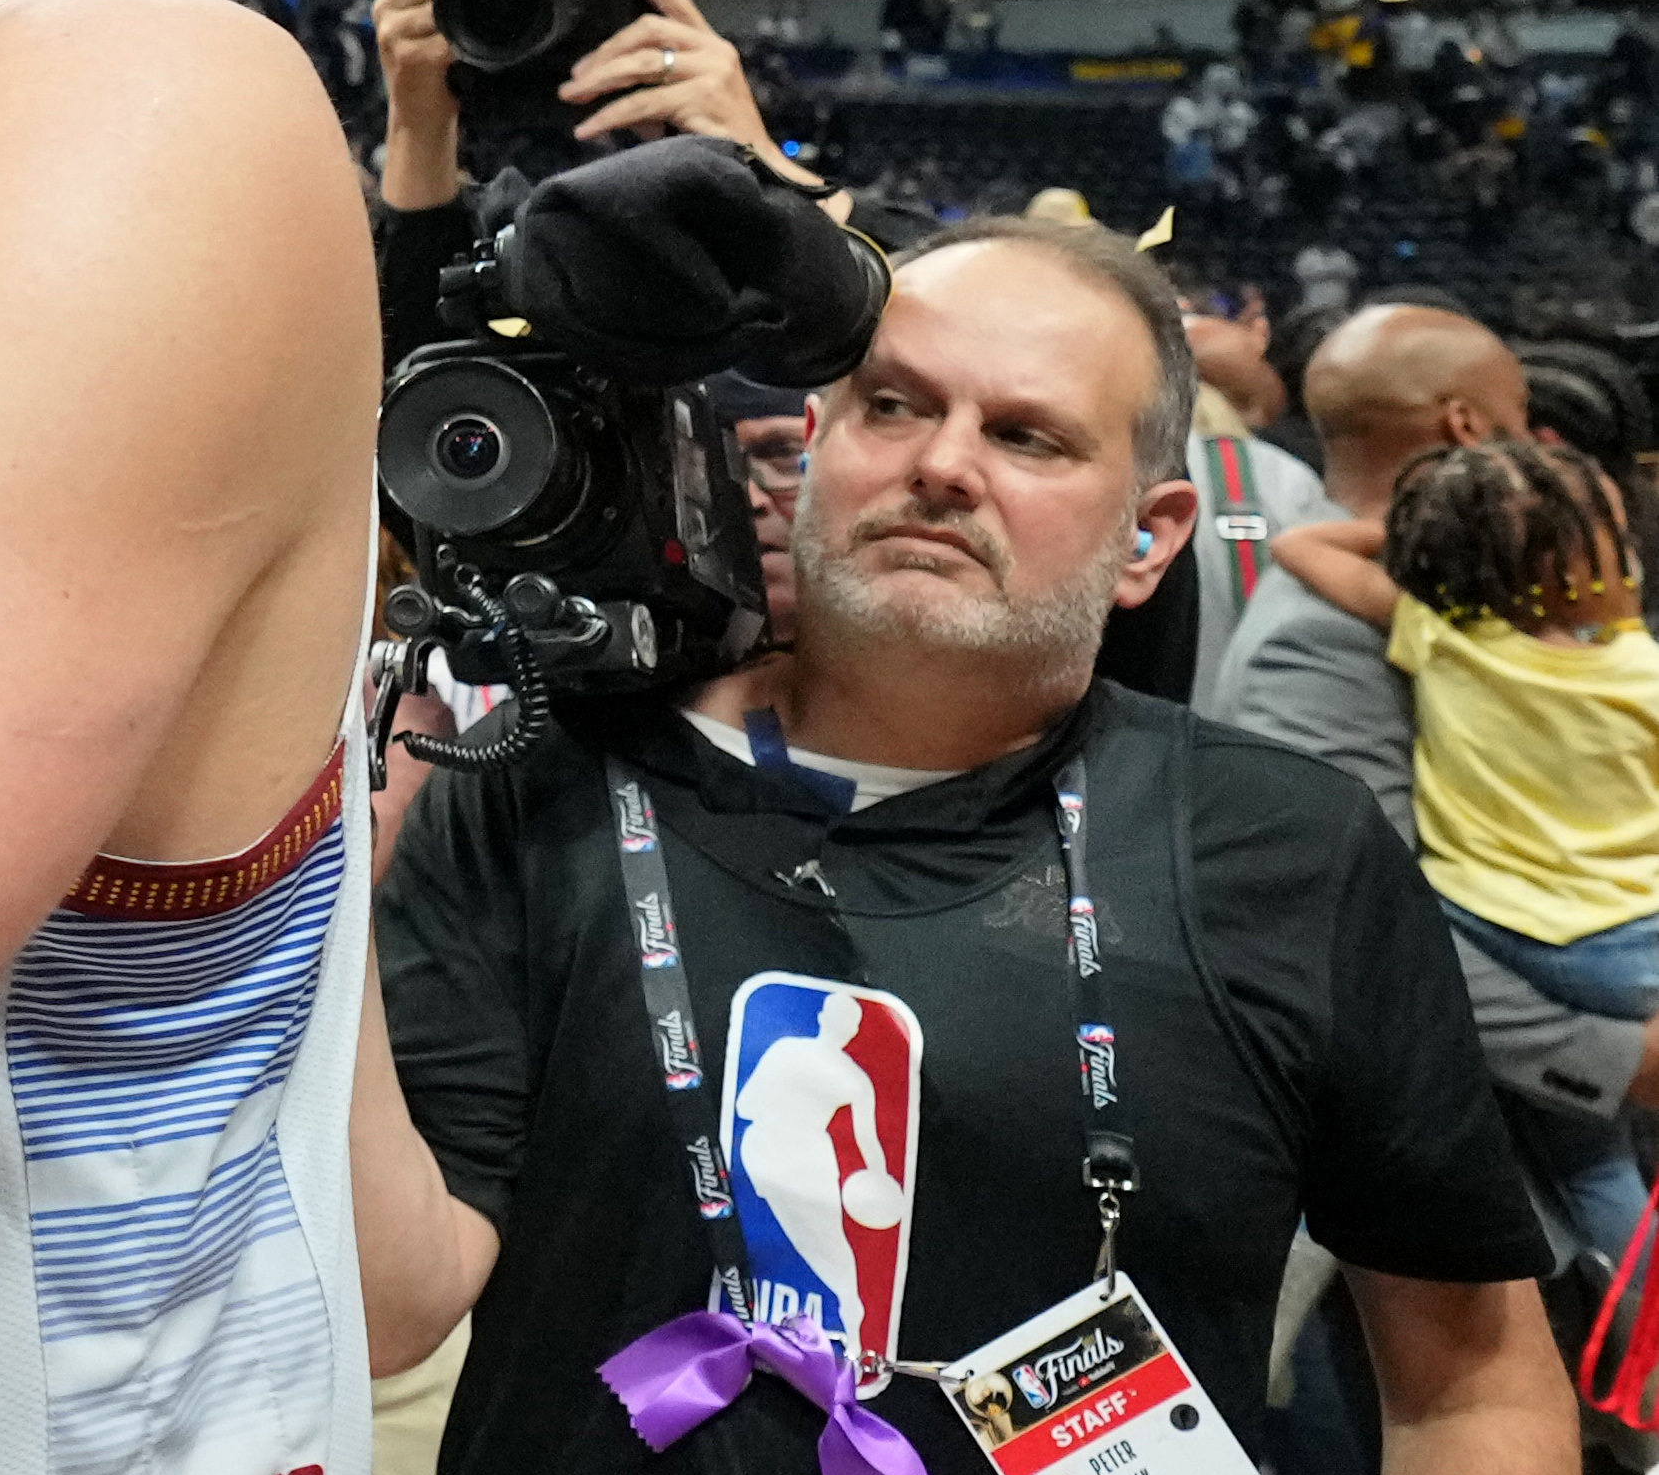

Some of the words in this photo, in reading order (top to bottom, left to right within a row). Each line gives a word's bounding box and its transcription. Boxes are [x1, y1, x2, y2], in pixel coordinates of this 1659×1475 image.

[636, 892, 678, 955] Finals
[1070, 914, 1103, 979] Finals
[657, 1010, 704, 1077] Finals
[1075, 1036, 1119, 1109] Finals
[686, 1135, 734, 1204] Finals
[1034, 1327, 1125, 1412] Finals
[1051, 1390, 1128, 1449] STAFF
